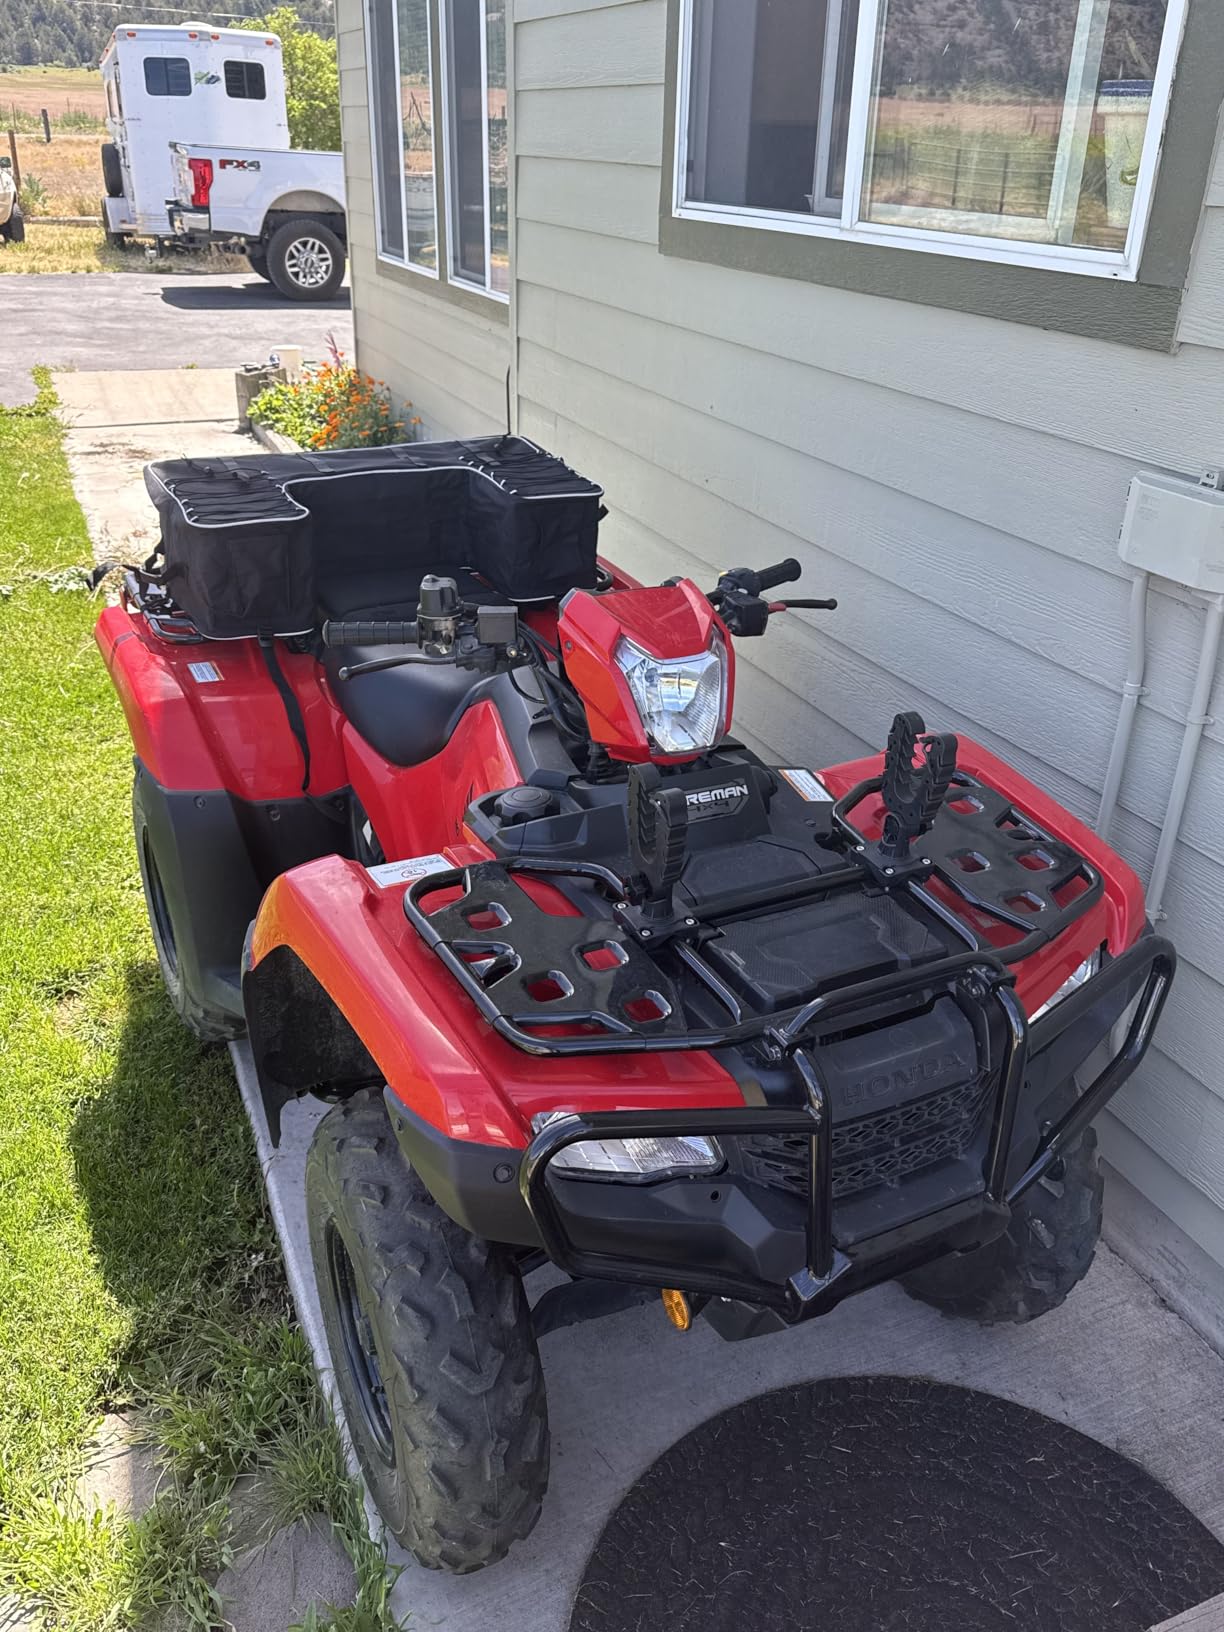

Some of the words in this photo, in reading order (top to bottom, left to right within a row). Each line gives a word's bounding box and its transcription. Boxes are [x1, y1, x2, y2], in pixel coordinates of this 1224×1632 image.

[219, 159, 260, 170] FX4
[685, 784, 749, 806] REMAN
[842, 1052, 966, 1105] HONDA
